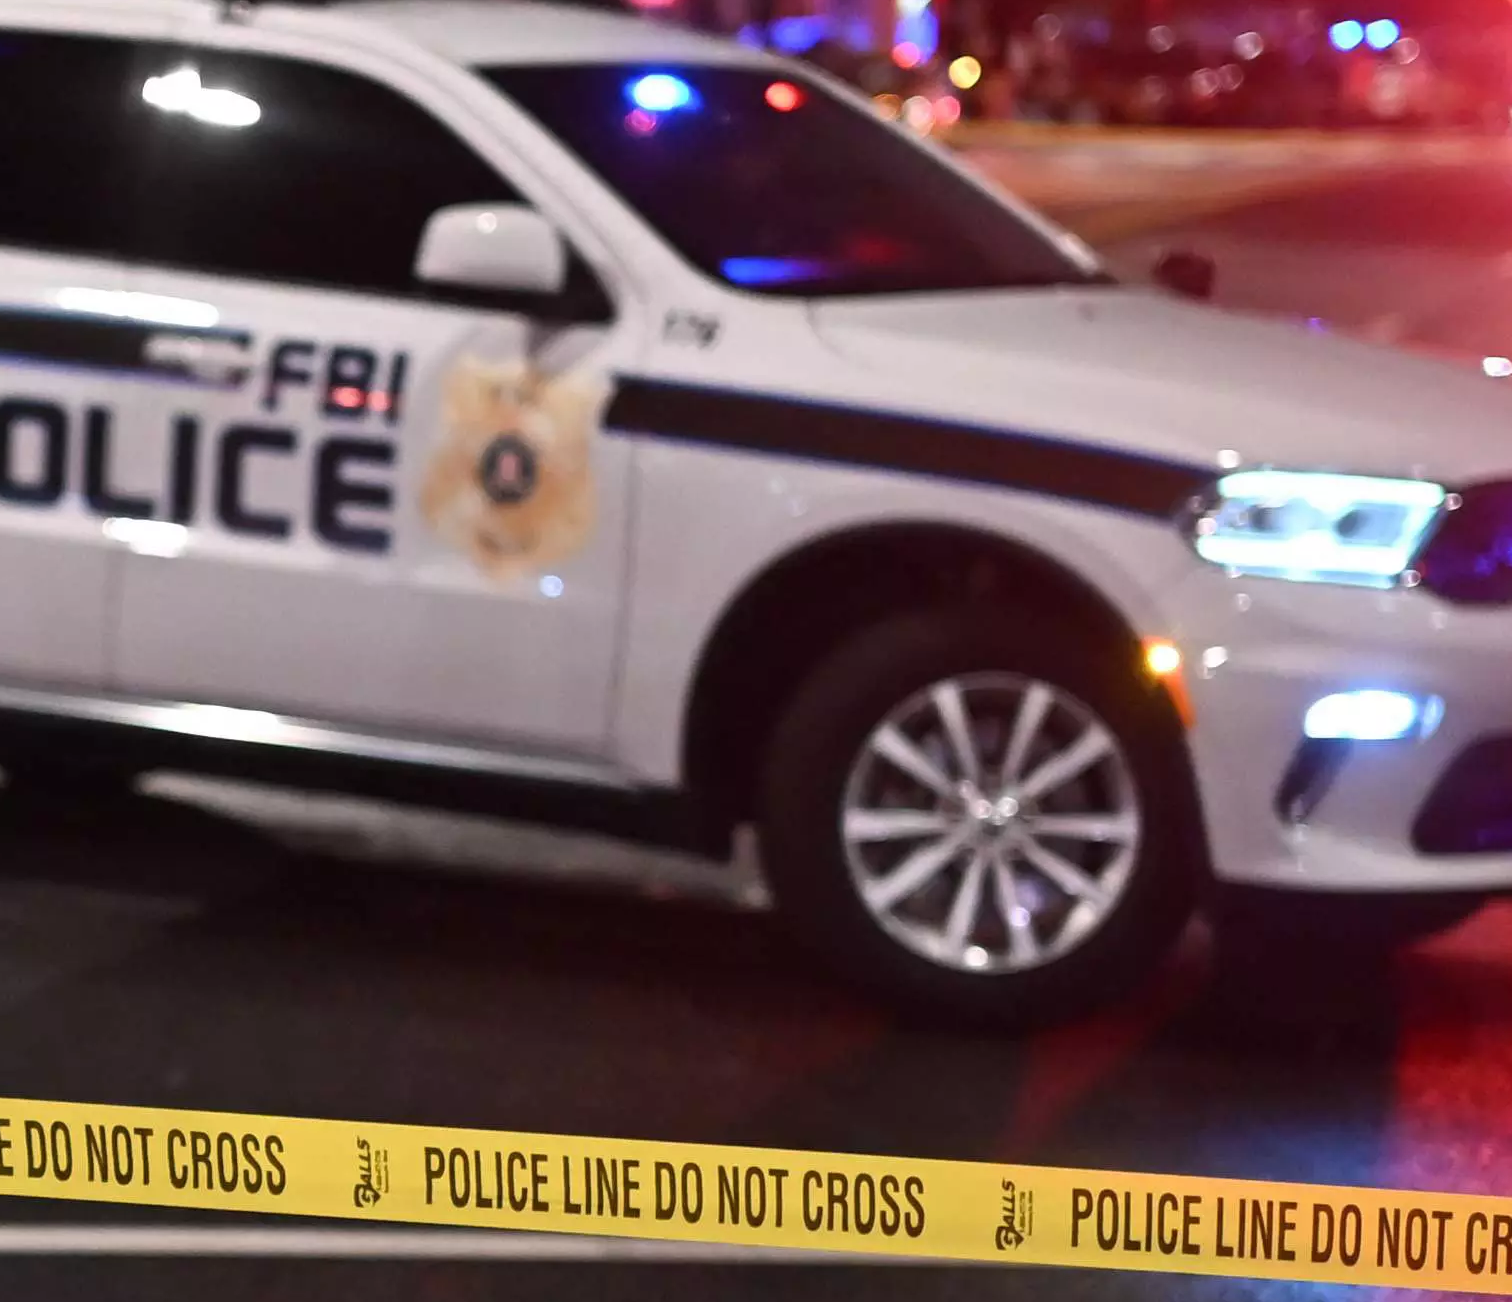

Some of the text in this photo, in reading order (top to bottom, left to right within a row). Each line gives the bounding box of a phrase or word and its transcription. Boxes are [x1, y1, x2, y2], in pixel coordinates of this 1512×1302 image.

[262, 338, 407, 426] FBI
[23, 1119, 73, 1182] DO
[84, 1123, 154, 1186] NOT
[167, 1128, 287, 1196] CROSS
[423, 1146, 550, 1213] POLICE
[562, 1155, 641, 1219] LINE
[654, 1161, 704, 1224] DO
[717, 1164, 790, 1229] NOT
[802, 1169, 925, 1238] CROSS
[1071, 1187, 1202, 1256] POLICE
[1215, 1196, 1298, 1262] LINE
[1310, 1203, 1363, 1267] DO
[1376, 1207, 1454, 1271] NOT
